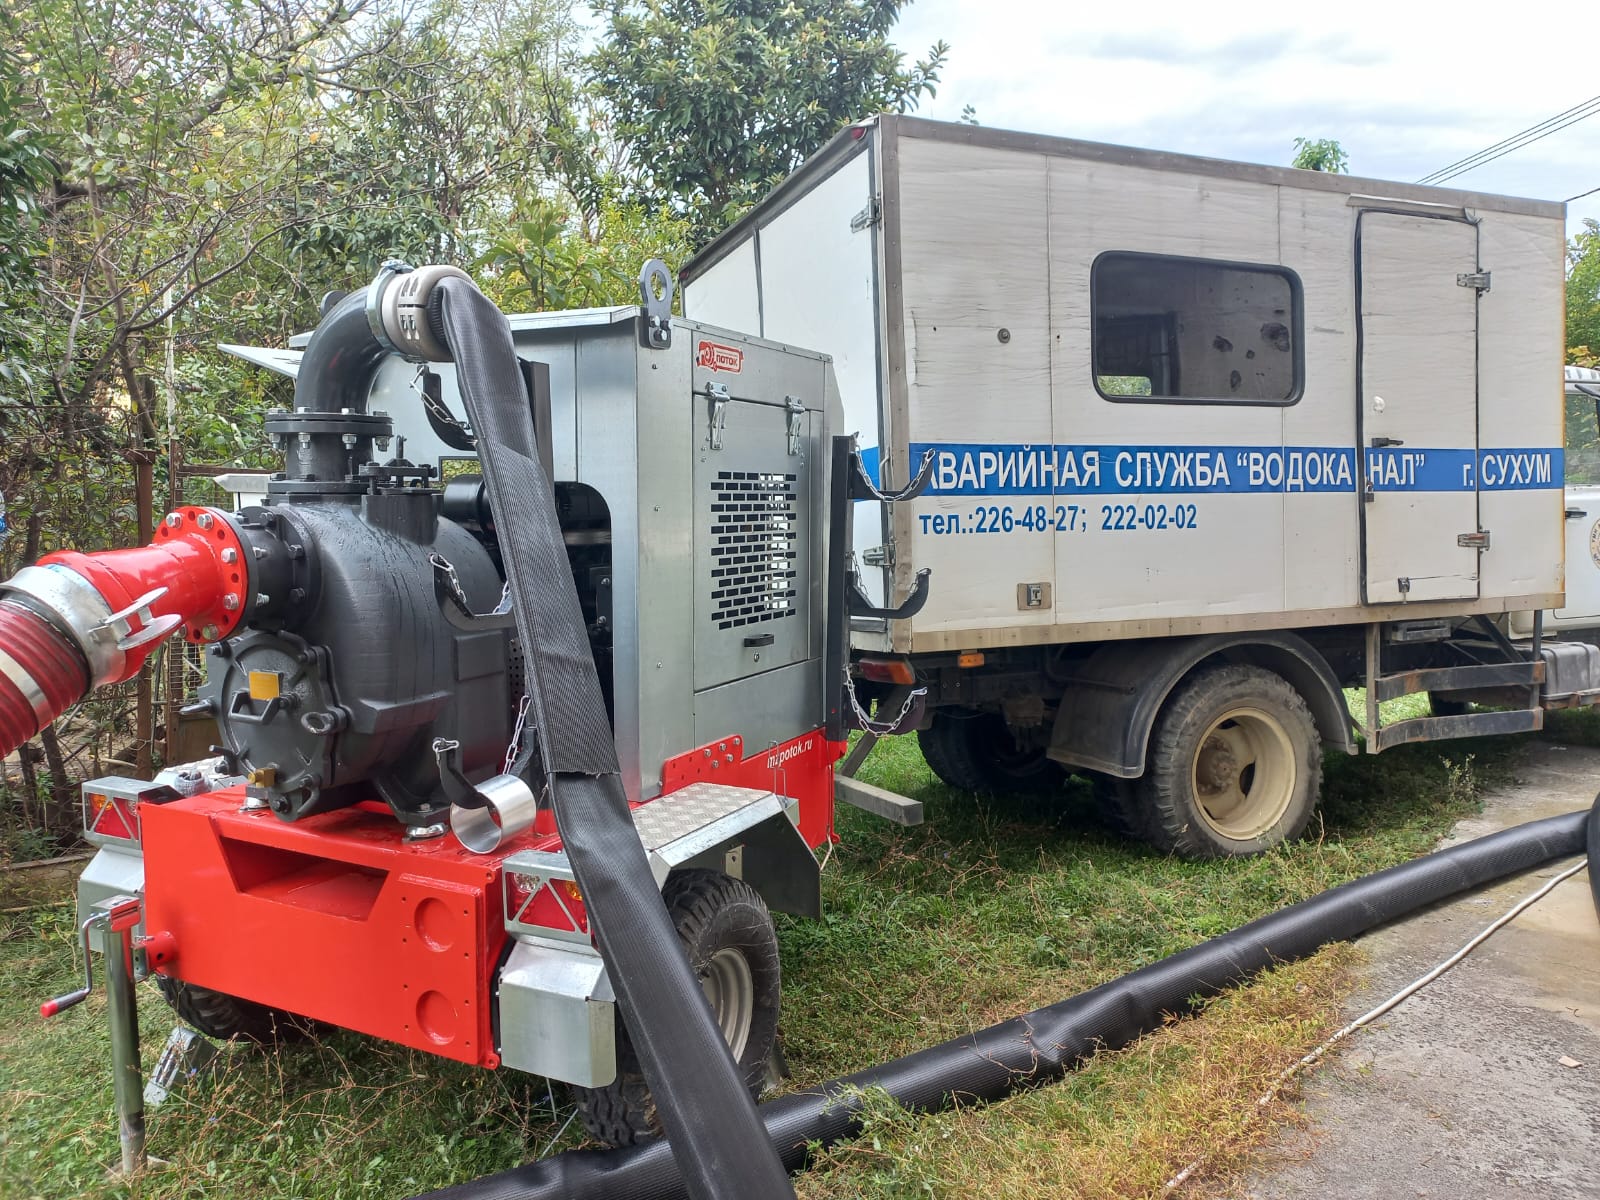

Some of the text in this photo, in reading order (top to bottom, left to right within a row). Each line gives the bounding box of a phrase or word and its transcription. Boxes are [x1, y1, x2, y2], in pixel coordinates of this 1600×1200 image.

[716, 354, 738, 367] ПОТОК
[930, 444, 1100, 490] ВАРИЙНАЯ
[1114, 451, 1231, 488] СЛУЖБА
[1463, 463, 1474, 487] г.
[1482, 453, 1551, 486] СУХУМ
[1101, 503, 1197, 531] 222-02-02
